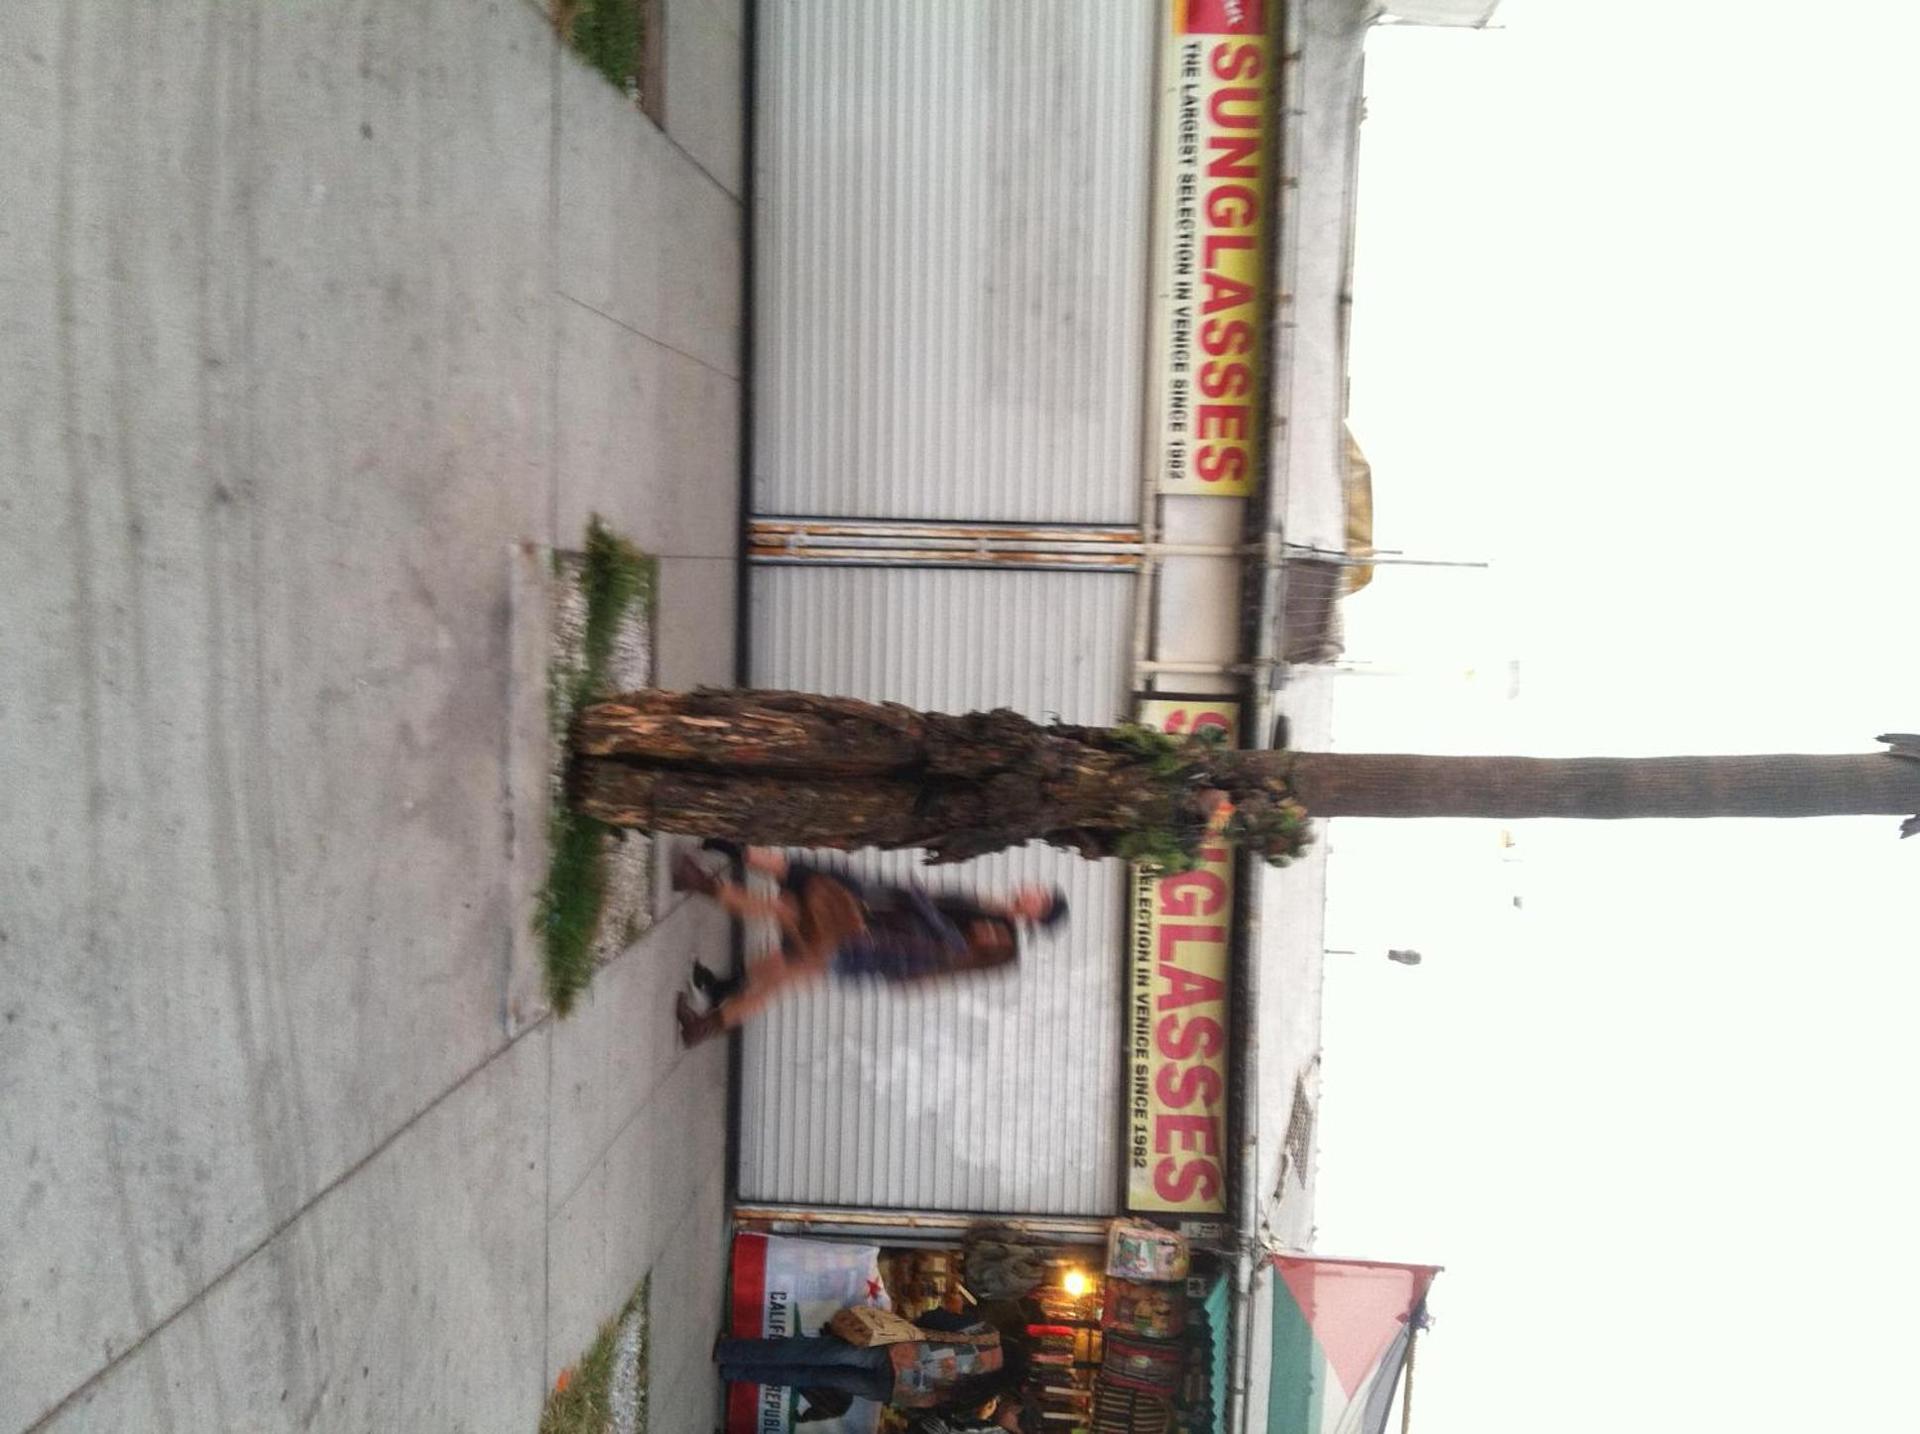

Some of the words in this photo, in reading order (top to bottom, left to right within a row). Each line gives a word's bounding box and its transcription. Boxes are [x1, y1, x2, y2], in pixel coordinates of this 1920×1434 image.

[1181, 42, 1201, 78] THE
[1179, 84, 1200, 165] LARGEST
[1176, 174, 1198, 275] SELECTION
[1195, 43, 1264, 482] SUNGLASSES
[1176, 282, 1192, 300] IN
[1172, 307, 1191, 373] VENICE
[1170, 379, 1189, 433] SINCE
[1136, 866, 1153, 962] SELECTION
[1136, 968, 1150, 987] IN
[1153, 710, 1233, 1204] SGLASSES
[1135, 994, 1150, 1058] VENICE
[1134, 1063, 1149, 1119] SINCE
[1133, 1124, 1148, 1169] 1982
[769, 1291, 787, 1341] CALIFO
[764, 1385, 782, 1434] REPUBL
